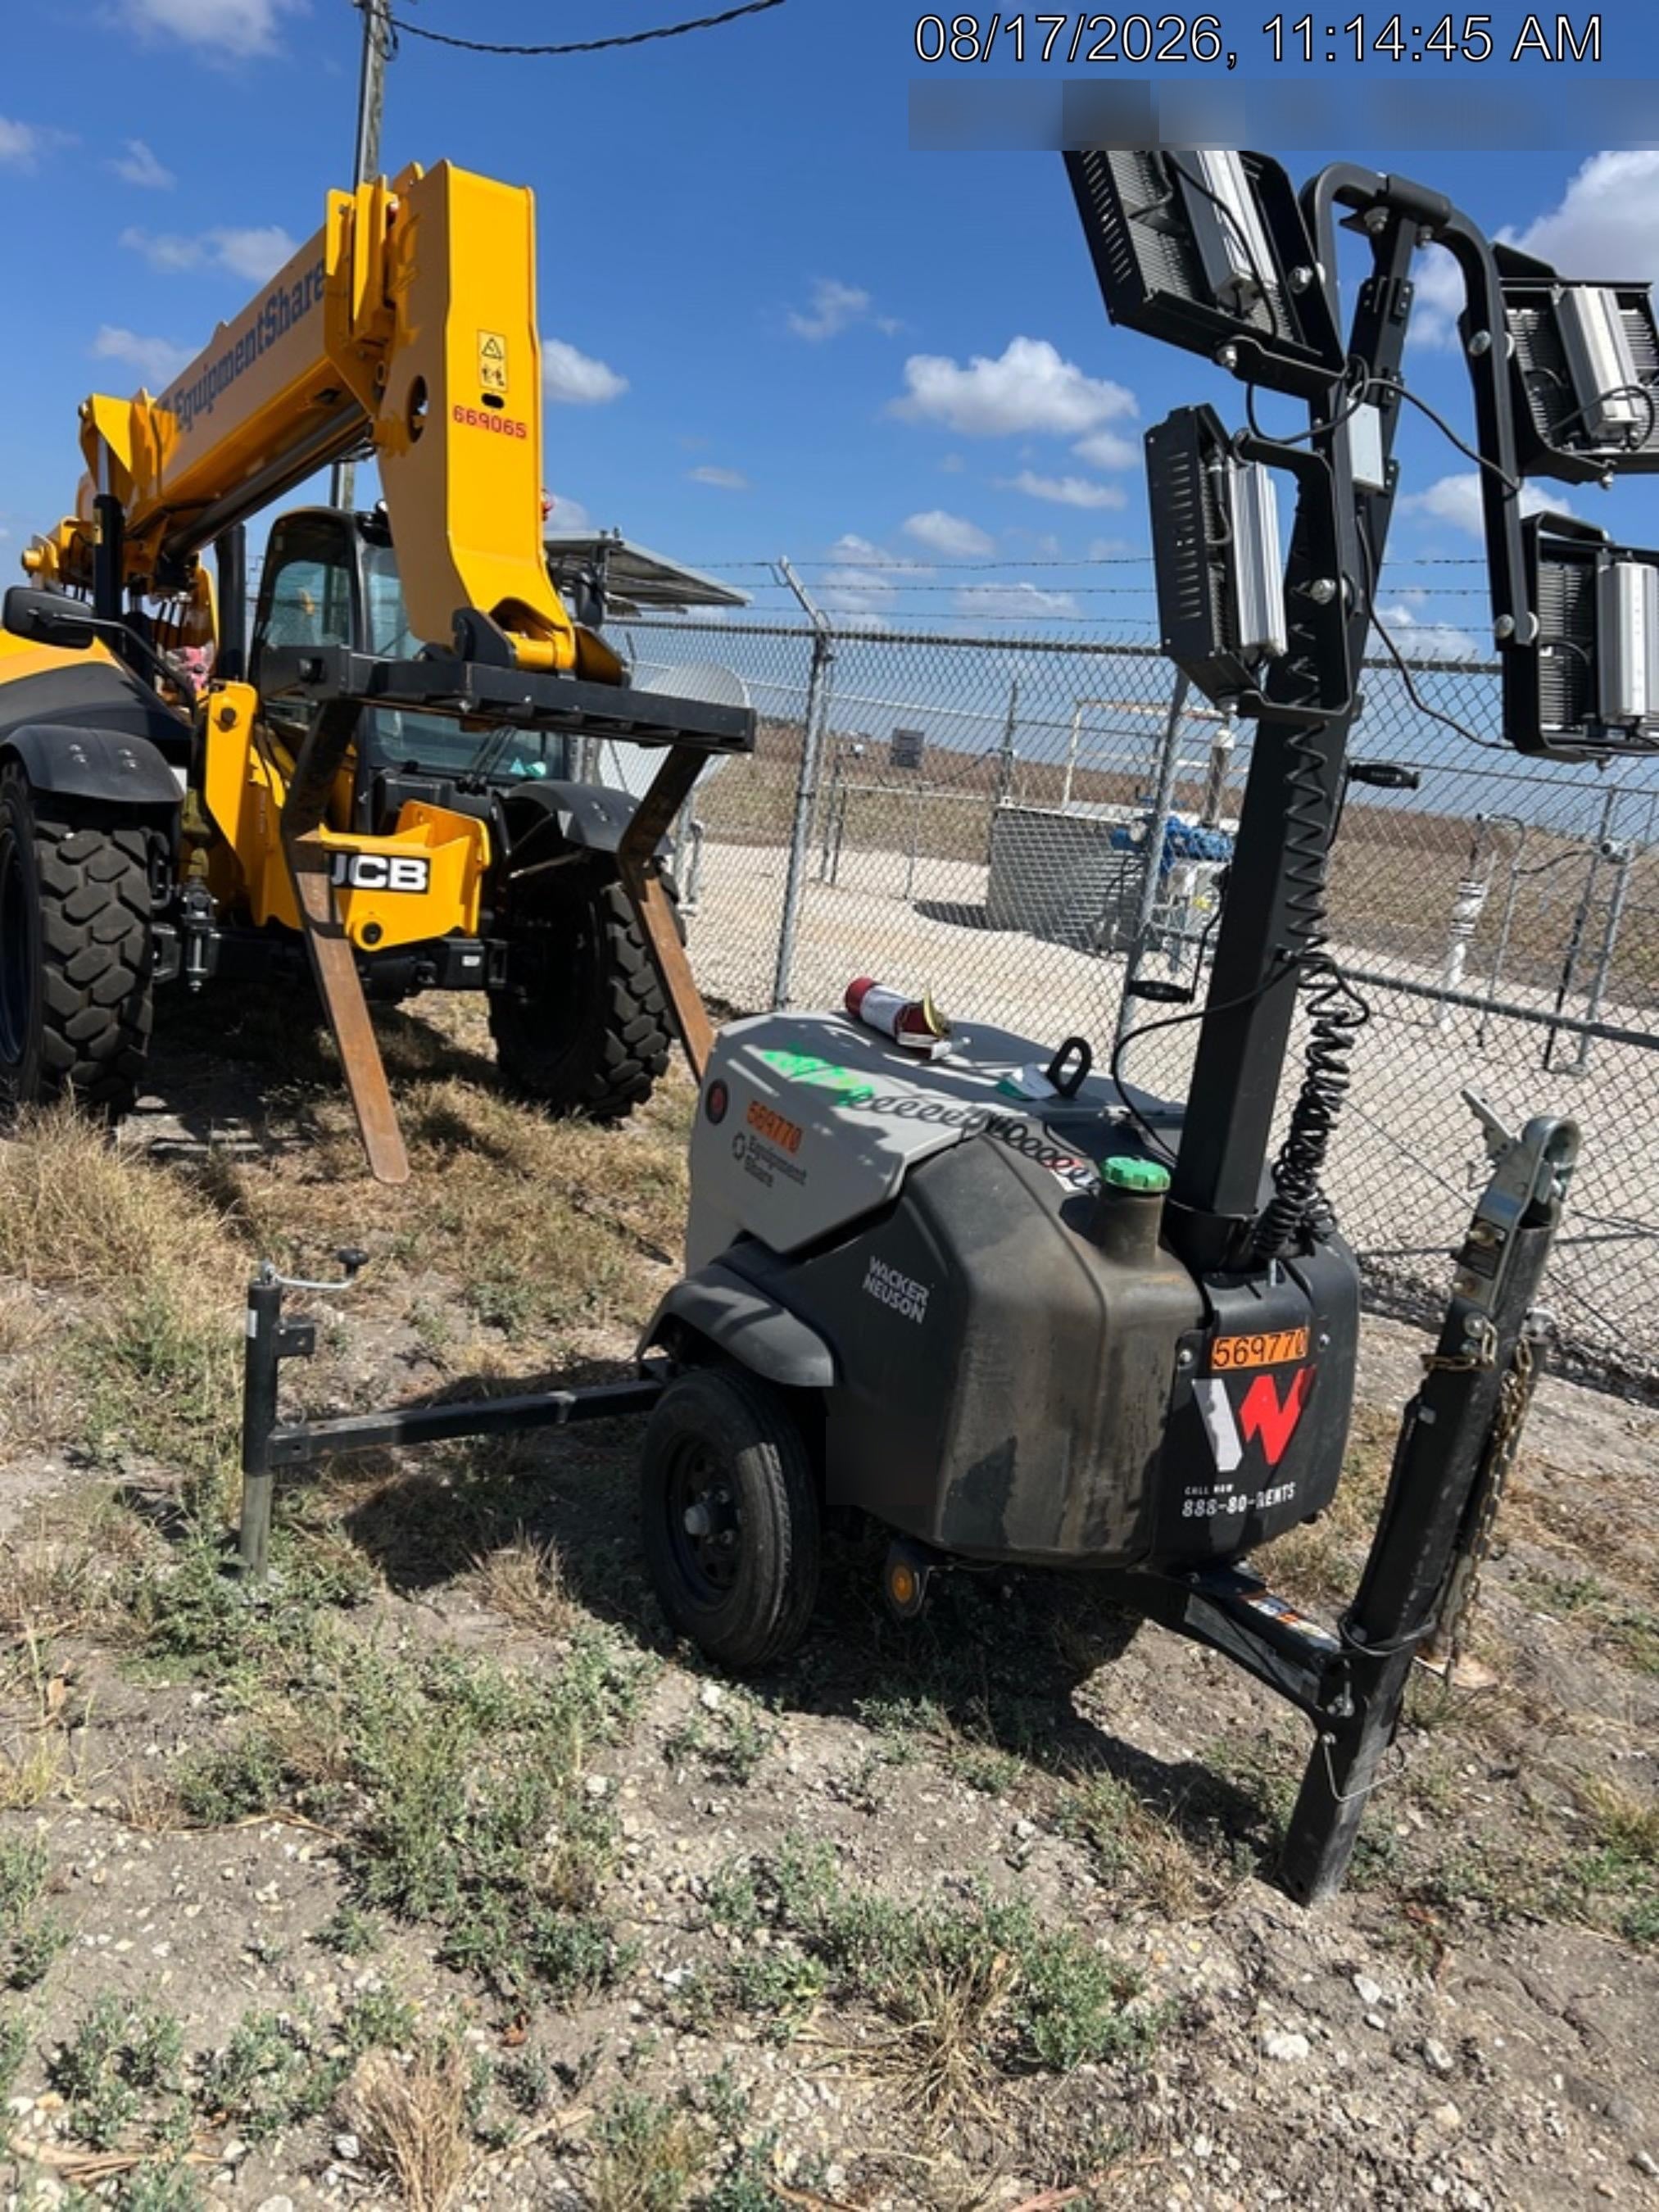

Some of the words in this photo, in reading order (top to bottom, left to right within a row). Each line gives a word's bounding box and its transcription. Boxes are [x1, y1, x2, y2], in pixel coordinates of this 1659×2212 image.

[174, 257, 326, 433] EquipmentShare
[452, 405, 528, 439] 669065
[331, 854, 427, 891] JCB
[862, 1272, 926, 1325] NEUSON
[869, 1256, 929, 1306] WACKER
[1214, 1328, 1307, 1367] 569770
